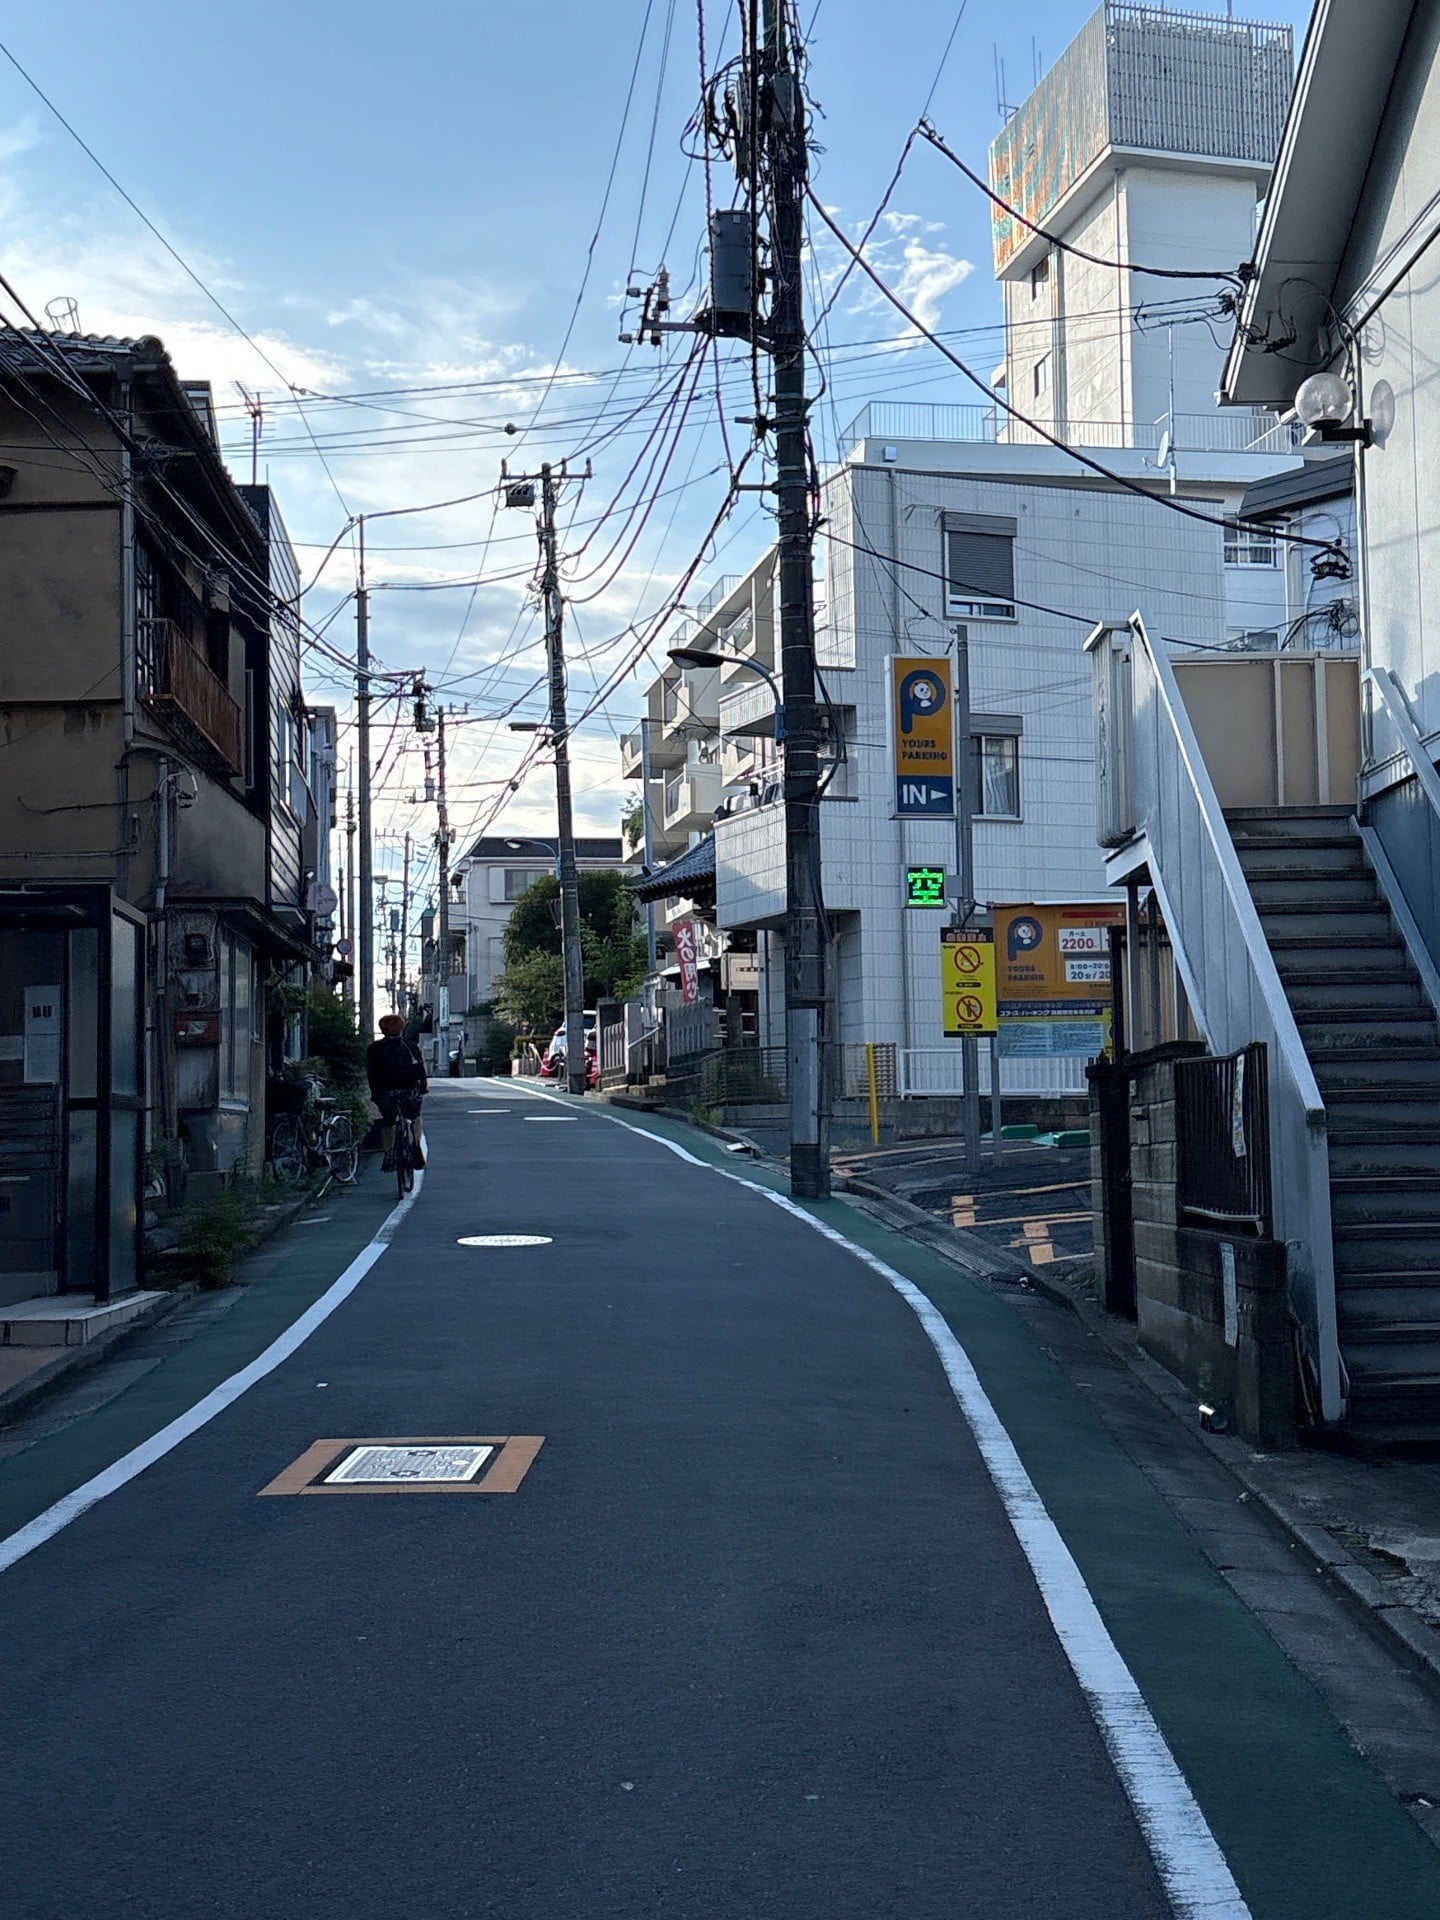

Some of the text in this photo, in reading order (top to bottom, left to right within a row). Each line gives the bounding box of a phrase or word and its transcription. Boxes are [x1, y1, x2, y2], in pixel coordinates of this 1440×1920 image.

[902, 739, 937, 748] YOURS
[902, 751, 948, 761] PARKING
[902, 783, 927, 805] IN
[907, 868, 943, 905] 空
[677, 927, 697, 1000] 火の用心
